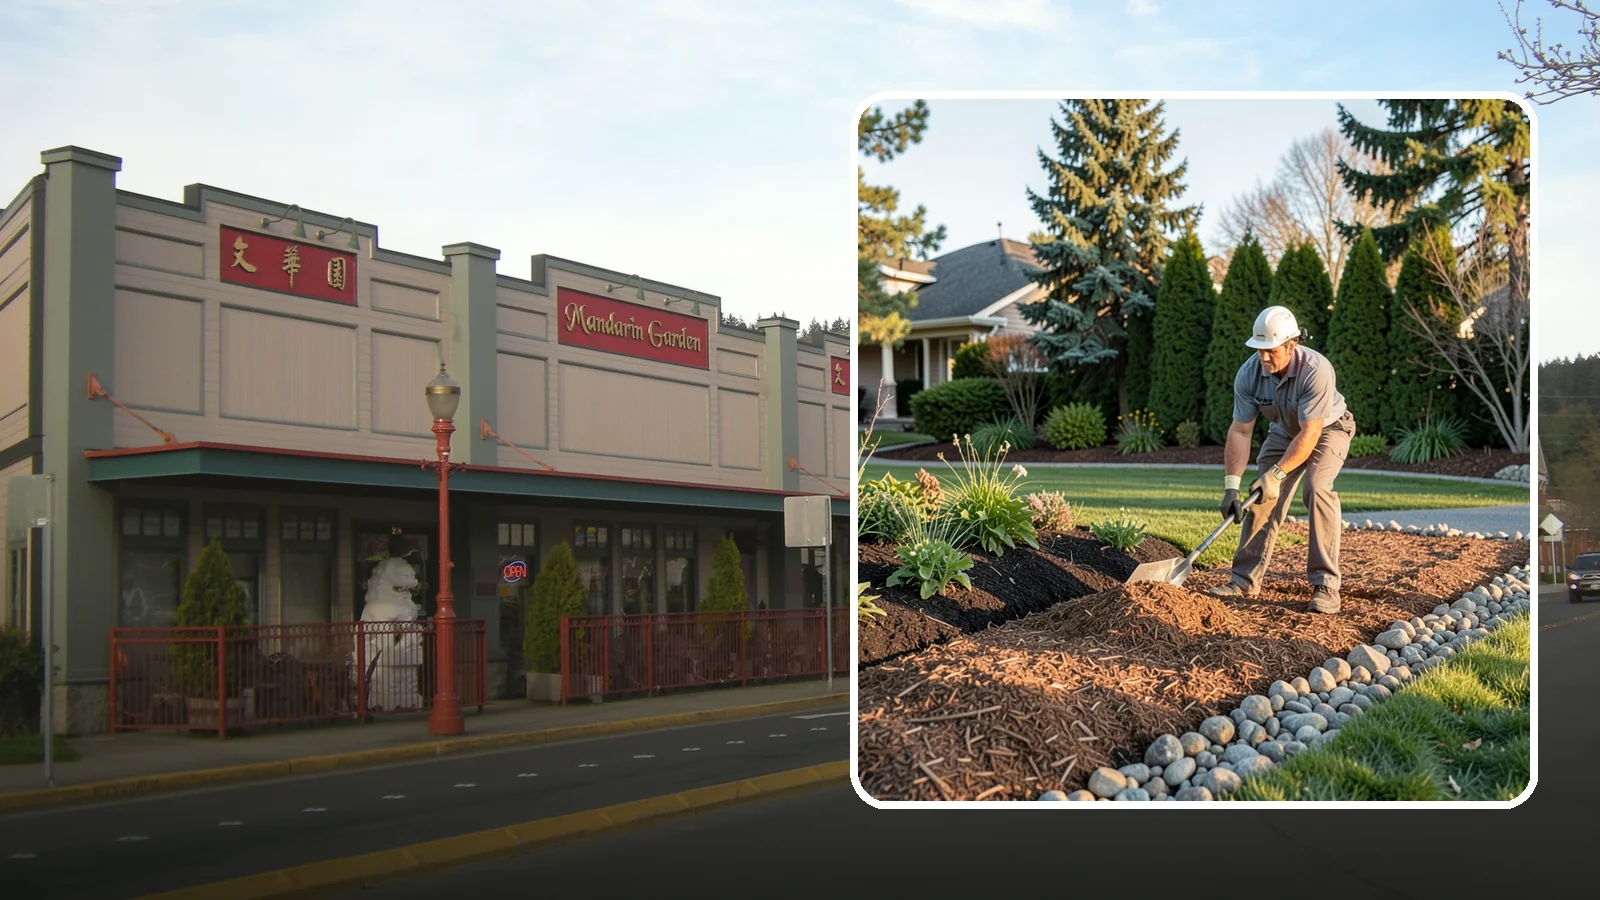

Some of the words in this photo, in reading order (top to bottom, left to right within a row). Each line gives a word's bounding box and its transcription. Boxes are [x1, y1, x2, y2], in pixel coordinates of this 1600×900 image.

[231, 235, 346, 290] 文華園
[564, 302, 644, 341] Mandarin
[647, 320, 702, 352] Garden
[503, 565, 527, 578] OPEN
